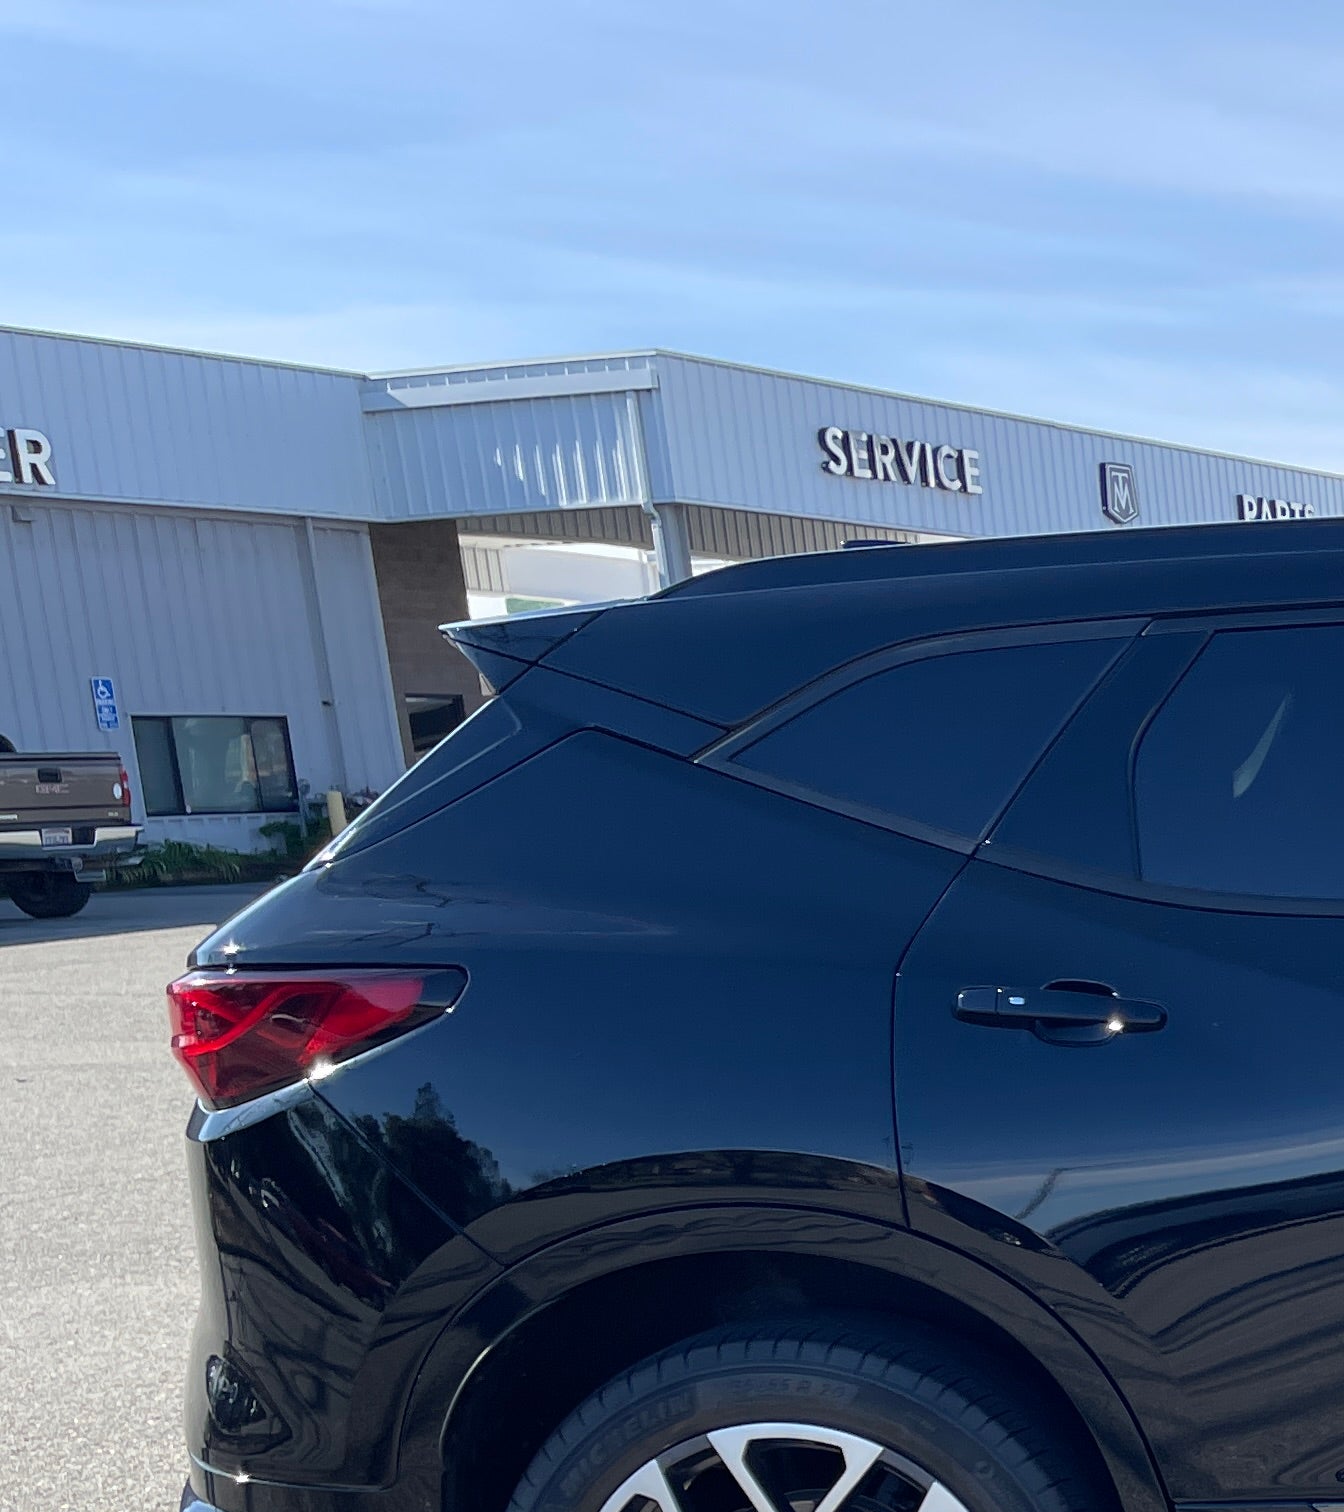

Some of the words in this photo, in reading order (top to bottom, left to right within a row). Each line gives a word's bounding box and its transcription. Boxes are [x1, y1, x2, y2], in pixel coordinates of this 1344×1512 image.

[0, 426, 56, 485] R
[818, 426, 983, 495] SERVICE
[555, 1390, 695, 1499] MICHELIN
